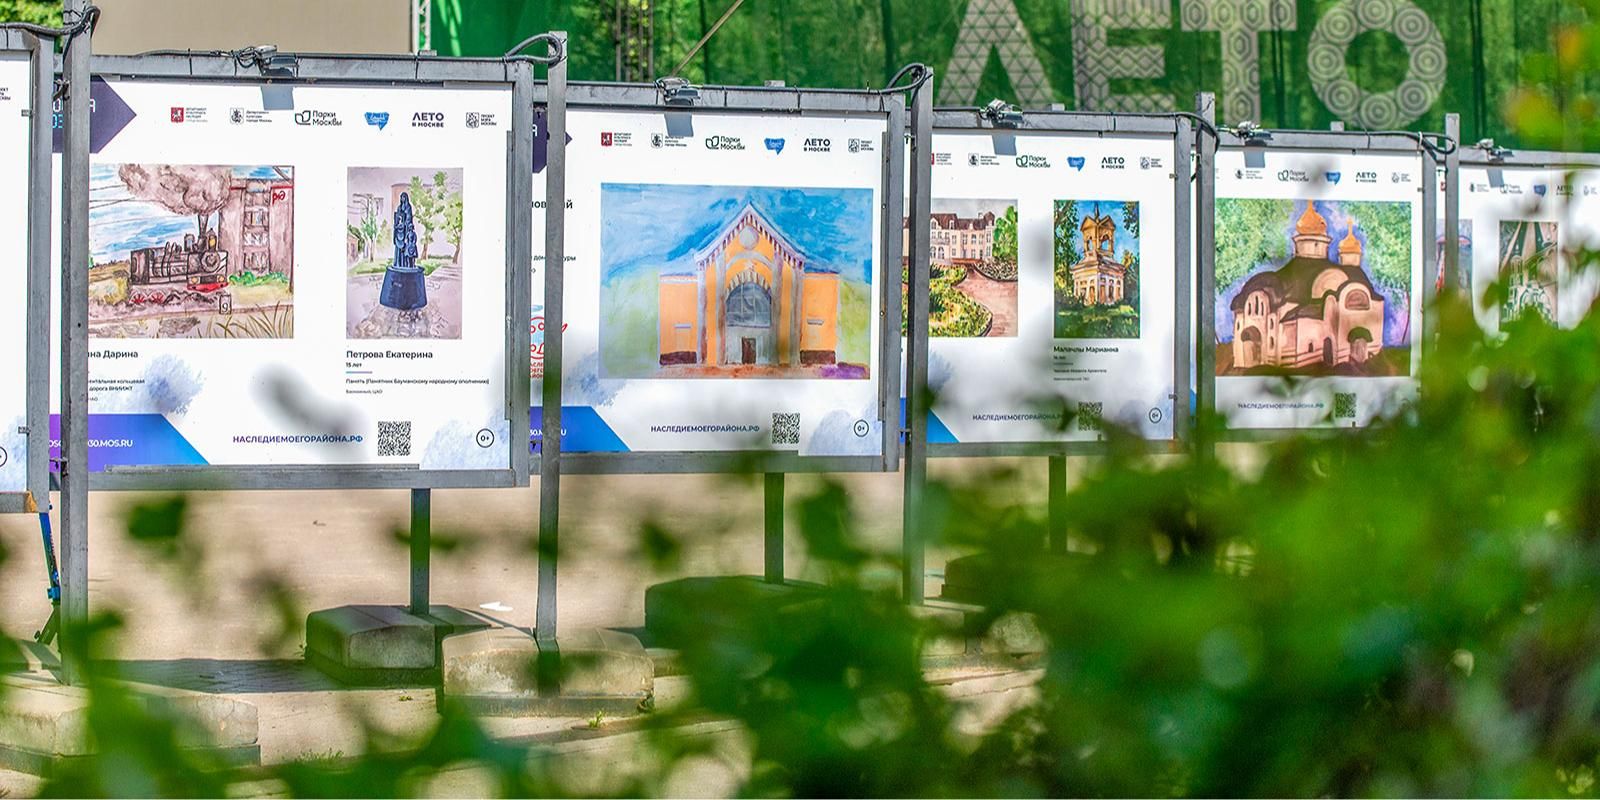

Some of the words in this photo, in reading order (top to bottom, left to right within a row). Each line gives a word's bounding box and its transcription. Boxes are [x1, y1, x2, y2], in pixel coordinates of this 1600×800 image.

[939, 0, 1447, 131] ЛЕТО
[312, 110, 336, 120] Парки
[412, 112, 444, 121] ЛЕТО
[312, 117, 342, 126] Москвы
[720, 135, 741, 145] Парки
[804, 138, 830, 146] ЛЕТО
[720, 142, 745, 150] Москвы
[1101, 156, 1125, 164] ЛЕТО
[103, 350, 138, 359] Дарина
[346, 350, 384, 360] Петрова
[386, 350, 433, 360] Екатерина
[650, 424, 760, 434] НАСЛЕДИЕМОЕГОРАЙОНА.РФ
[232, 433, 363, 444] НАСЛЕДИЕМОЕГОРАЙОНА.РФ
